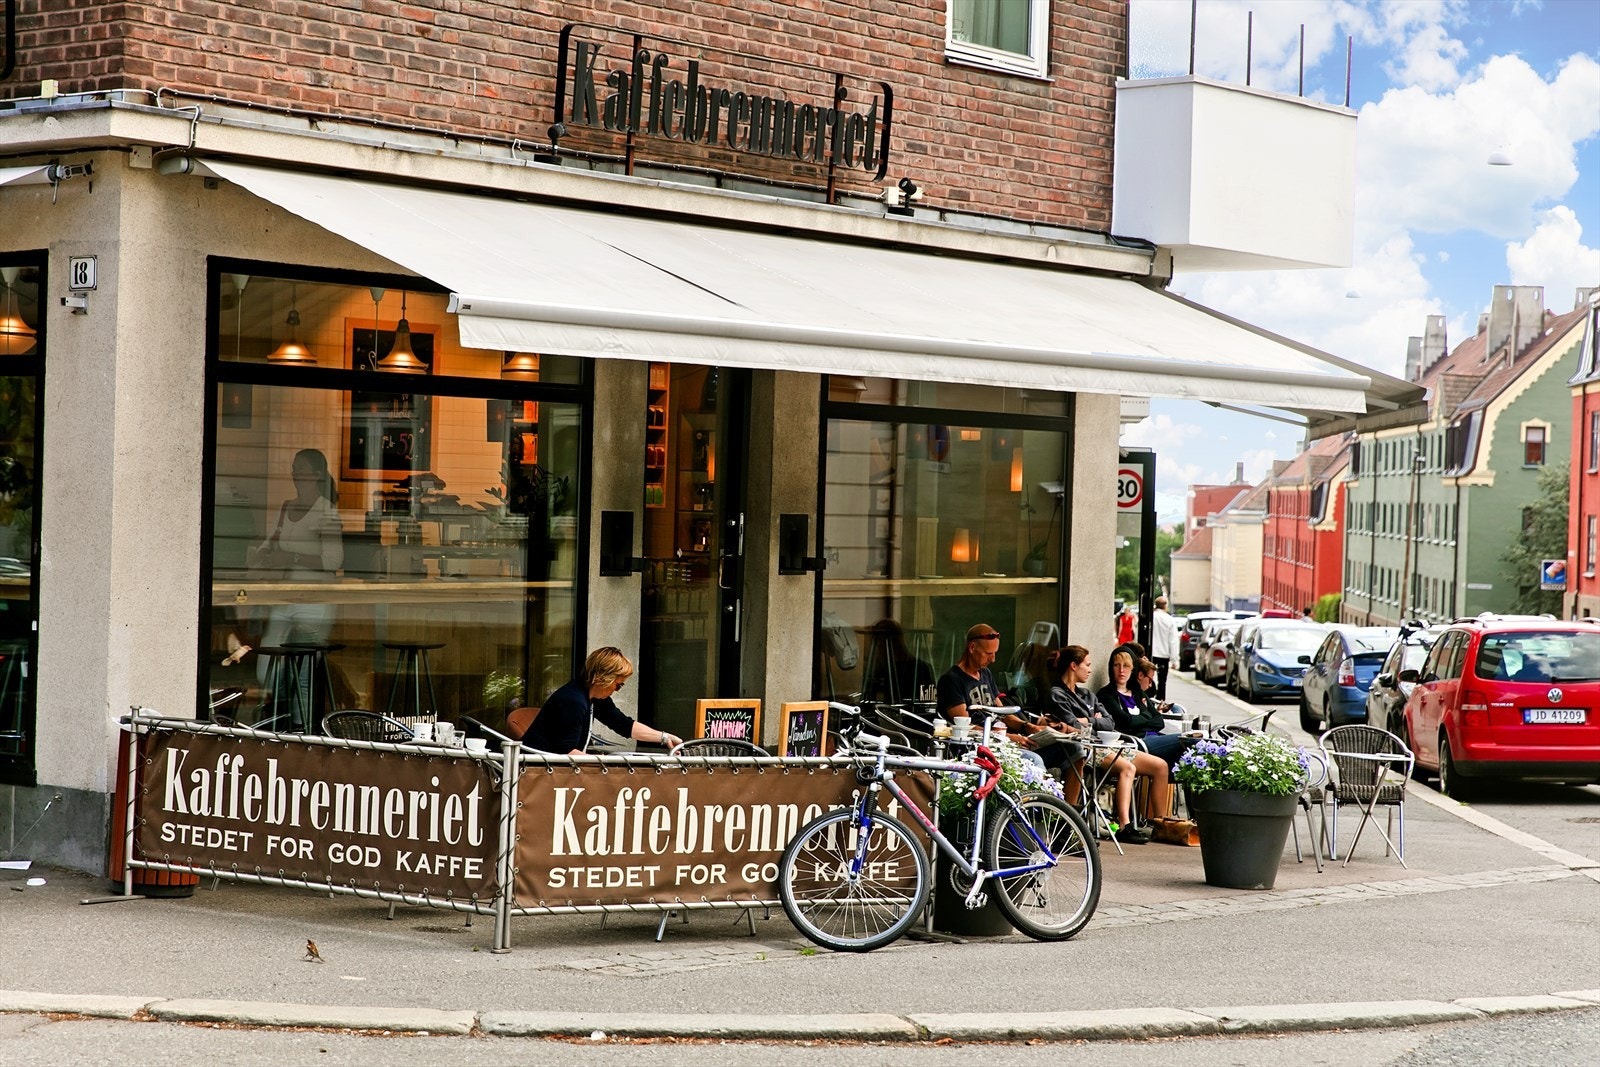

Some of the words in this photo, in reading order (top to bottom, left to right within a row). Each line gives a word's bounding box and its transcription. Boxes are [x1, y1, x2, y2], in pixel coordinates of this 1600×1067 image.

[571, 39, 881, 171] Kaffebrenneriet
[74, 261, 88, 285] 18
[1535, 710, 1547, 720] JD
[1551, 710, 1582, 720] 41209
[162, 747, 484, 847] Kaffebrenneriet
[160, 821, 254, 852] STEDET
[266, 834, 314, 860] FOR
[327, 842, 381, 868] GOD
[395, 850, 484, 879] KAFFE
[547, 865, 661, 889] STEDET
[675, 863, 727, 886] FOR
[814, 861, 900, 882] KAFE
